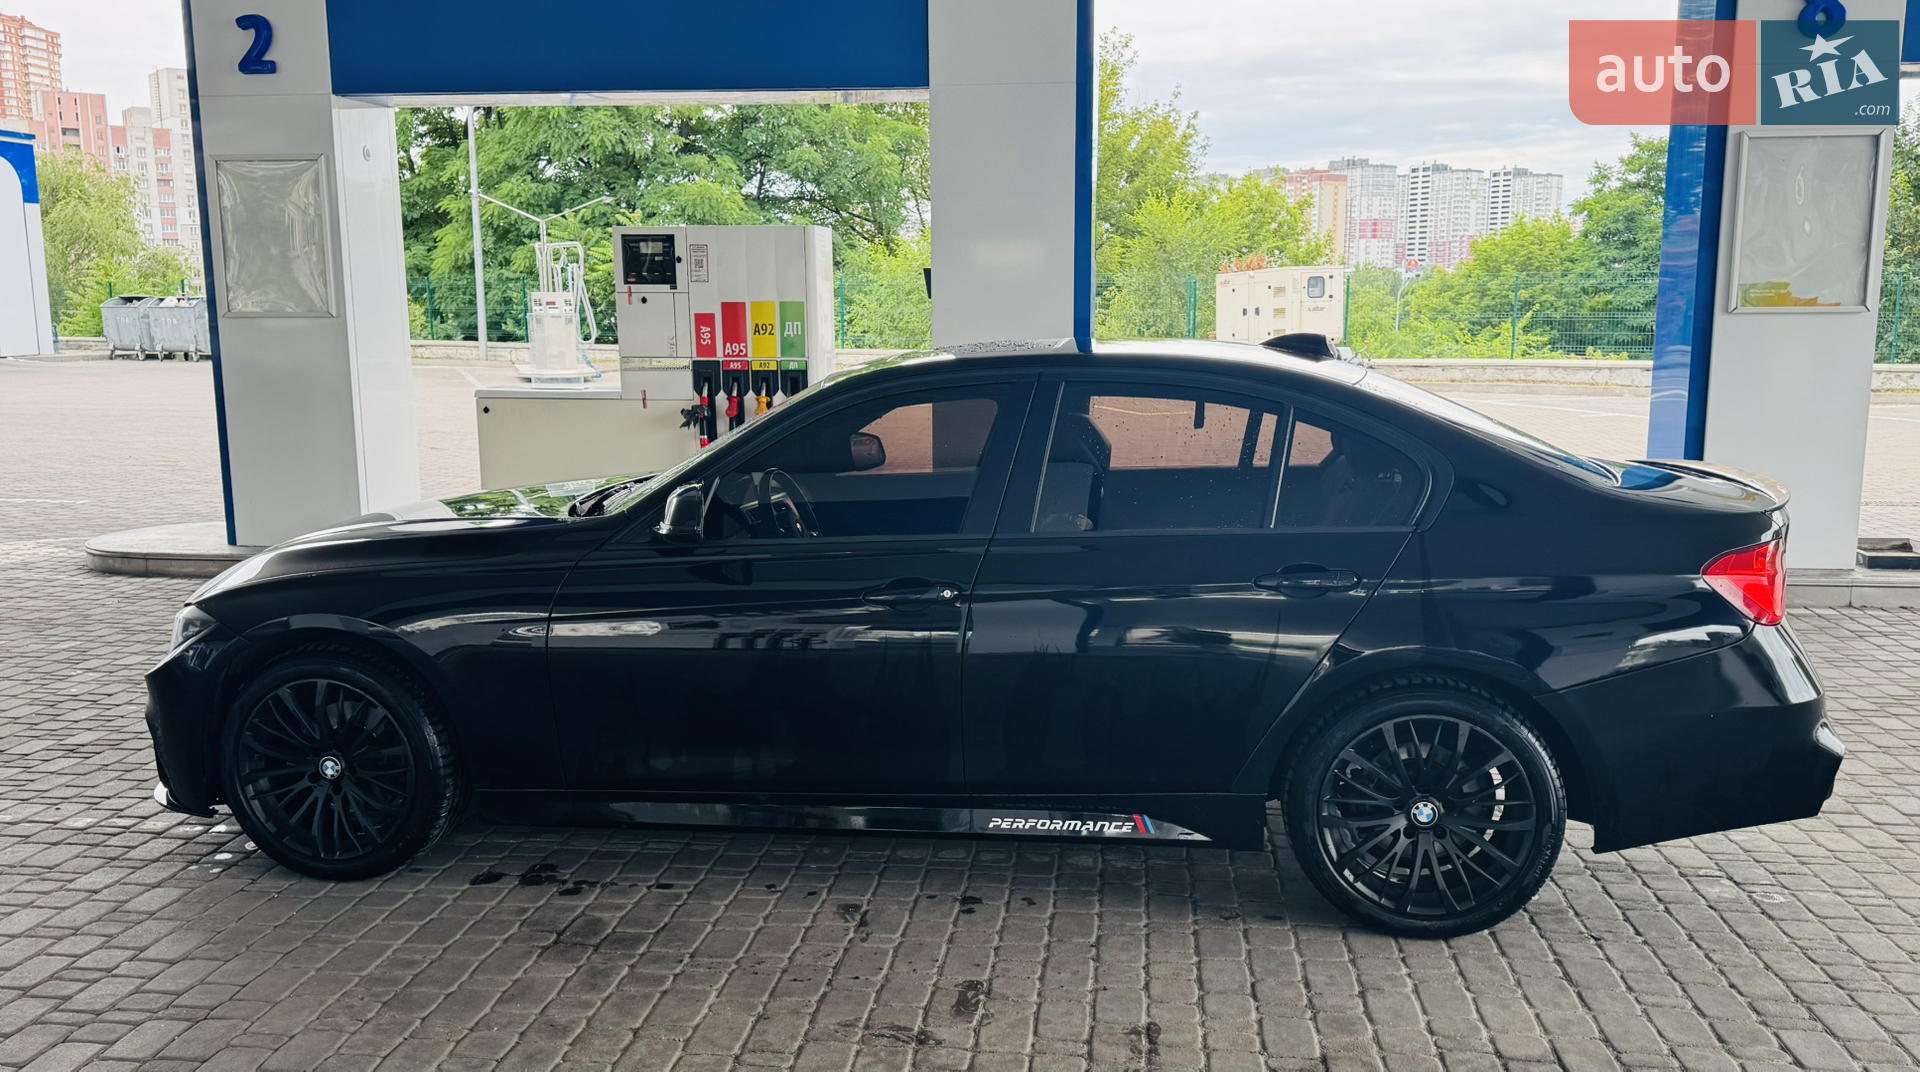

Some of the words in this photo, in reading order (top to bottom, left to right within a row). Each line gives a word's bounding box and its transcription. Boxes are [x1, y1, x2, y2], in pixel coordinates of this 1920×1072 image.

[235, 14, 277, 75] 2
[783, 321, 802, 338] ДП
[988, 817, 1135, 833] PERFORMANCE
